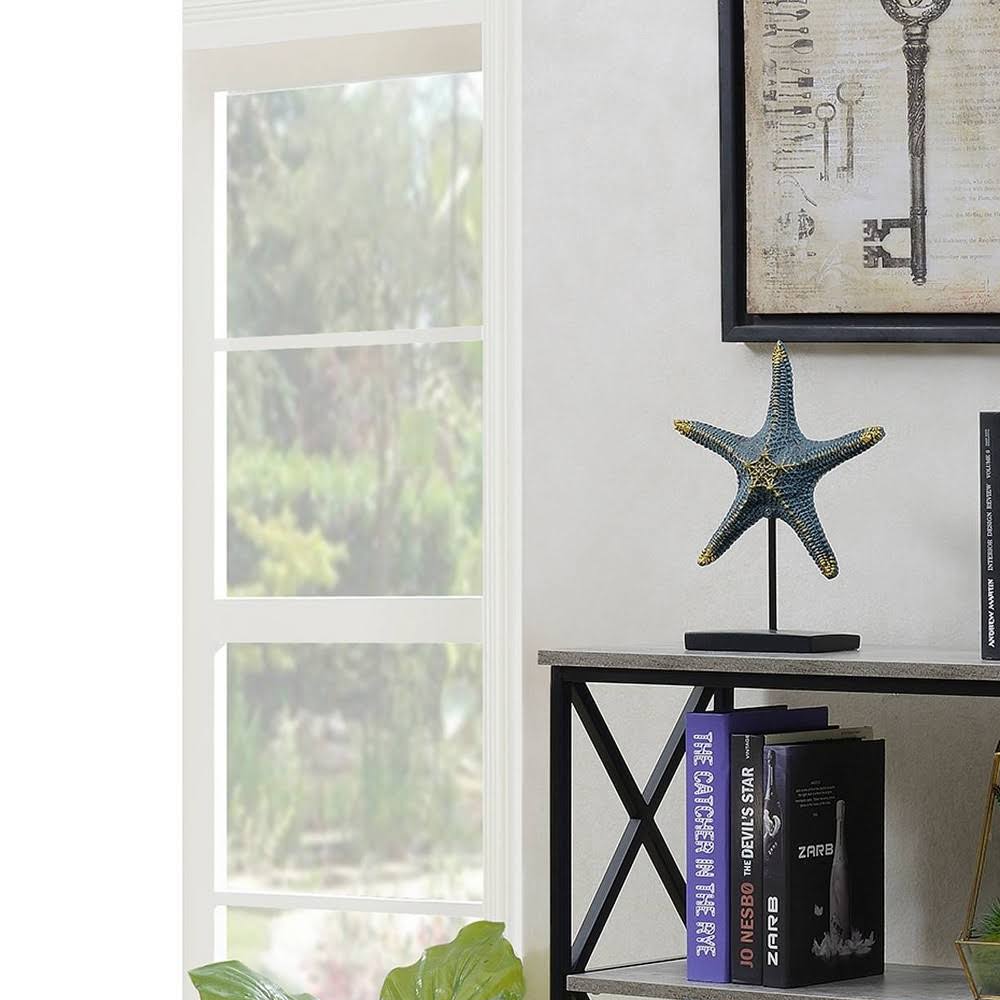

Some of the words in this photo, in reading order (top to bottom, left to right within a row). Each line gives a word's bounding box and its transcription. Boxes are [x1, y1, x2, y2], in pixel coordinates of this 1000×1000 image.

[985, 483, 993, 509] REVIEW
[986, 539, 994, 571] INTERIOR
[987, 611, 996, 648] ANDREW
[693, 731, 713, 766] THE
[741, 767, 755, 803] STAR
[693, 770, 715, 854] CATCHER
[741, 804, 755, 859] DEVIL'S
[694, 858, 715, 878] IN
[743, 859, 752, 877] THE
[798, 843, 834, 859] ZARB
[695, 882, 716, 918] THE
[696, 921, 717, 958] RYE
[767, 896, 779, 966] ZARB
[740, 945, 754, 969] JO
